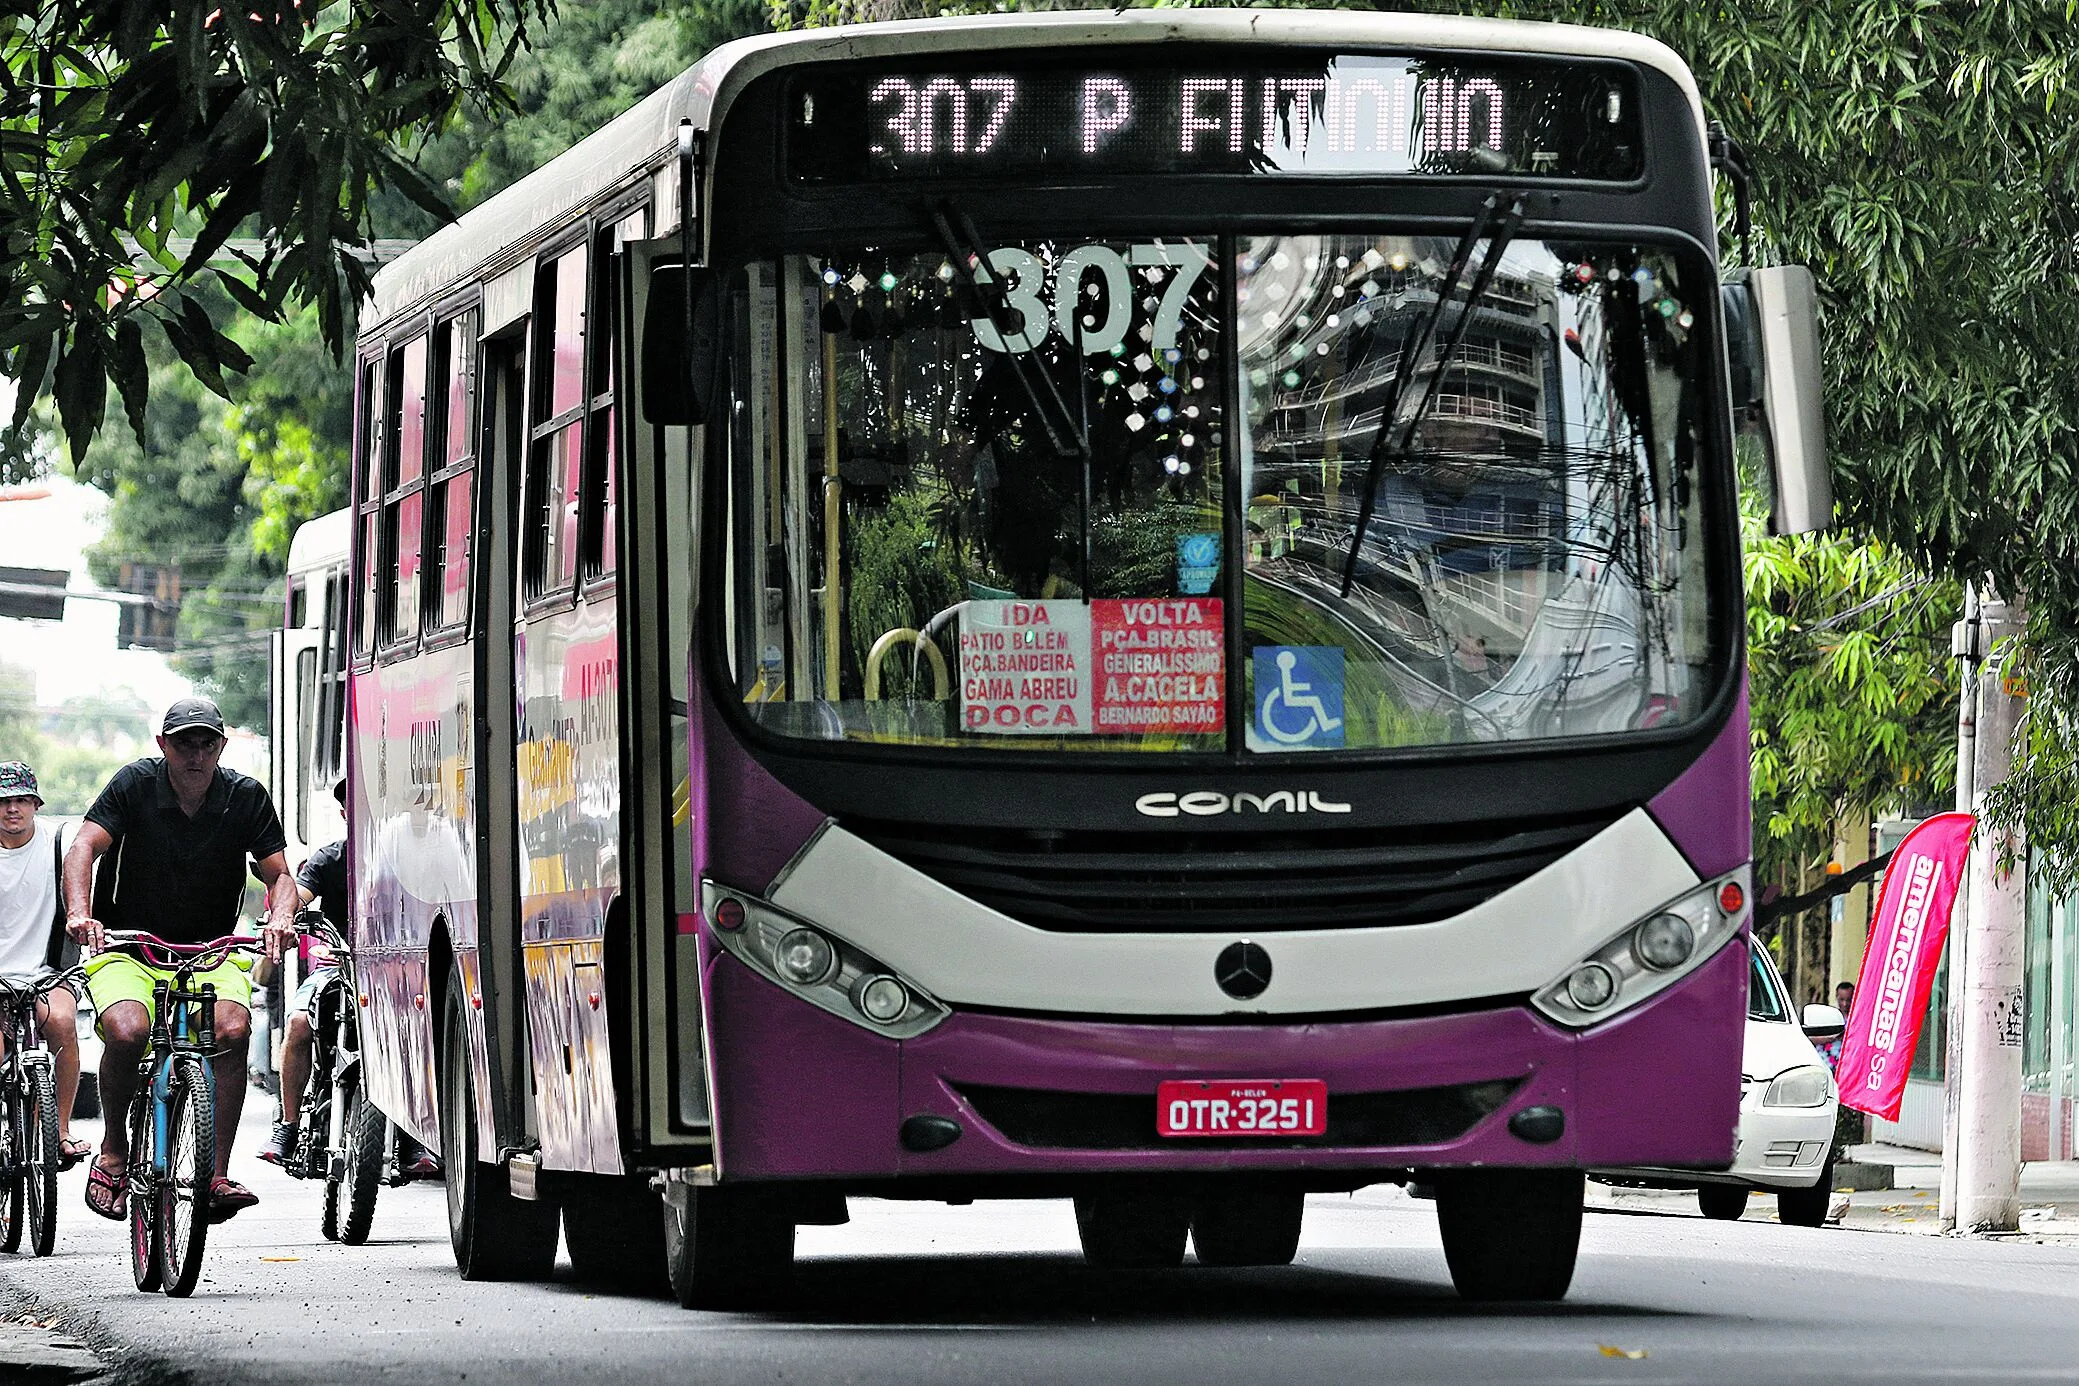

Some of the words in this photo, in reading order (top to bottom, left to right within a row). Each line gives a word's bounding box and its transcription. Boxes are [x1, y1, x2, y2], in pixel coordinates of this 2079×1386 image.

[871, 78, 1015, 152] 307
[1085, 78, 1129, 152] P
[971, 243, 1208, 356] 307
[1002, 603, 1050, 626] IDA
[1121, 602, 1203, 625] VOLTA
[965, 678, 1014, 701] GAMA
[1021, 678, 1078, 700] ABREU
[1103, 675, 1220, 702] A.CACELA
[966, 704, 1079, 727] DOCA
[1098, 706, 1171, 725] BERNARDO
[1172, 702, 1217, 724] SAYÃO
[1135, 791, 1352, 816] COMIL
[1875, 854, 1935, 1050] americanas
[1867, 1053, 1886, 1092] sa
